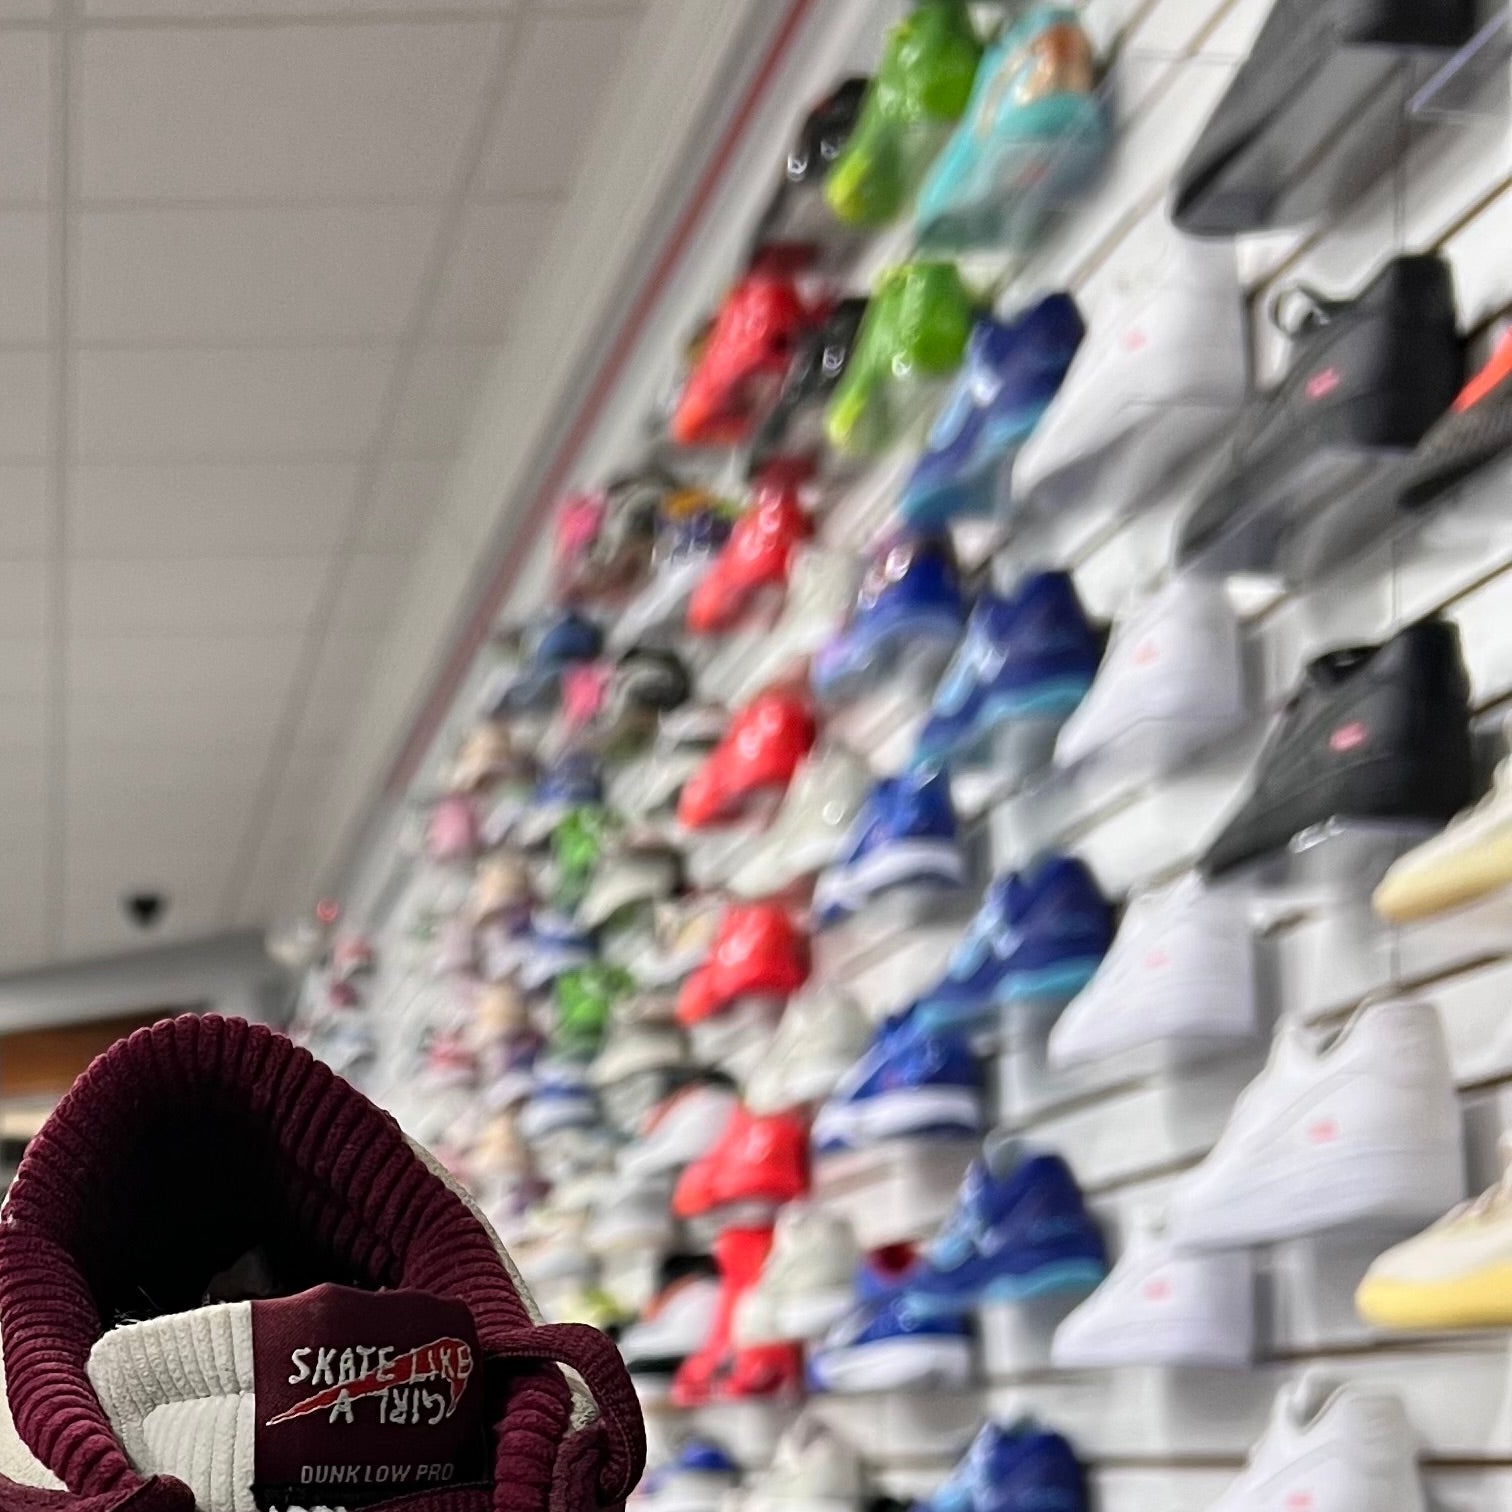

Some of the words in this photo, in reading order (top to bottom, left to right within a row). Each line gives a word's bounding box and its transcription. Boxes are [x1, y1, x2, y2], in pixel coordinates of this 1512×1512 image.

[289, 1346, 394, 1385] SKATE
[409, 1345, 471, 1384] LIKE
[329, 1388, 354, 1424] A
[301, 1465, 361, 1484] DUNK
[364, 1465, 411, 1483] LOW
[415, 1463, 454, 1481] PRO
